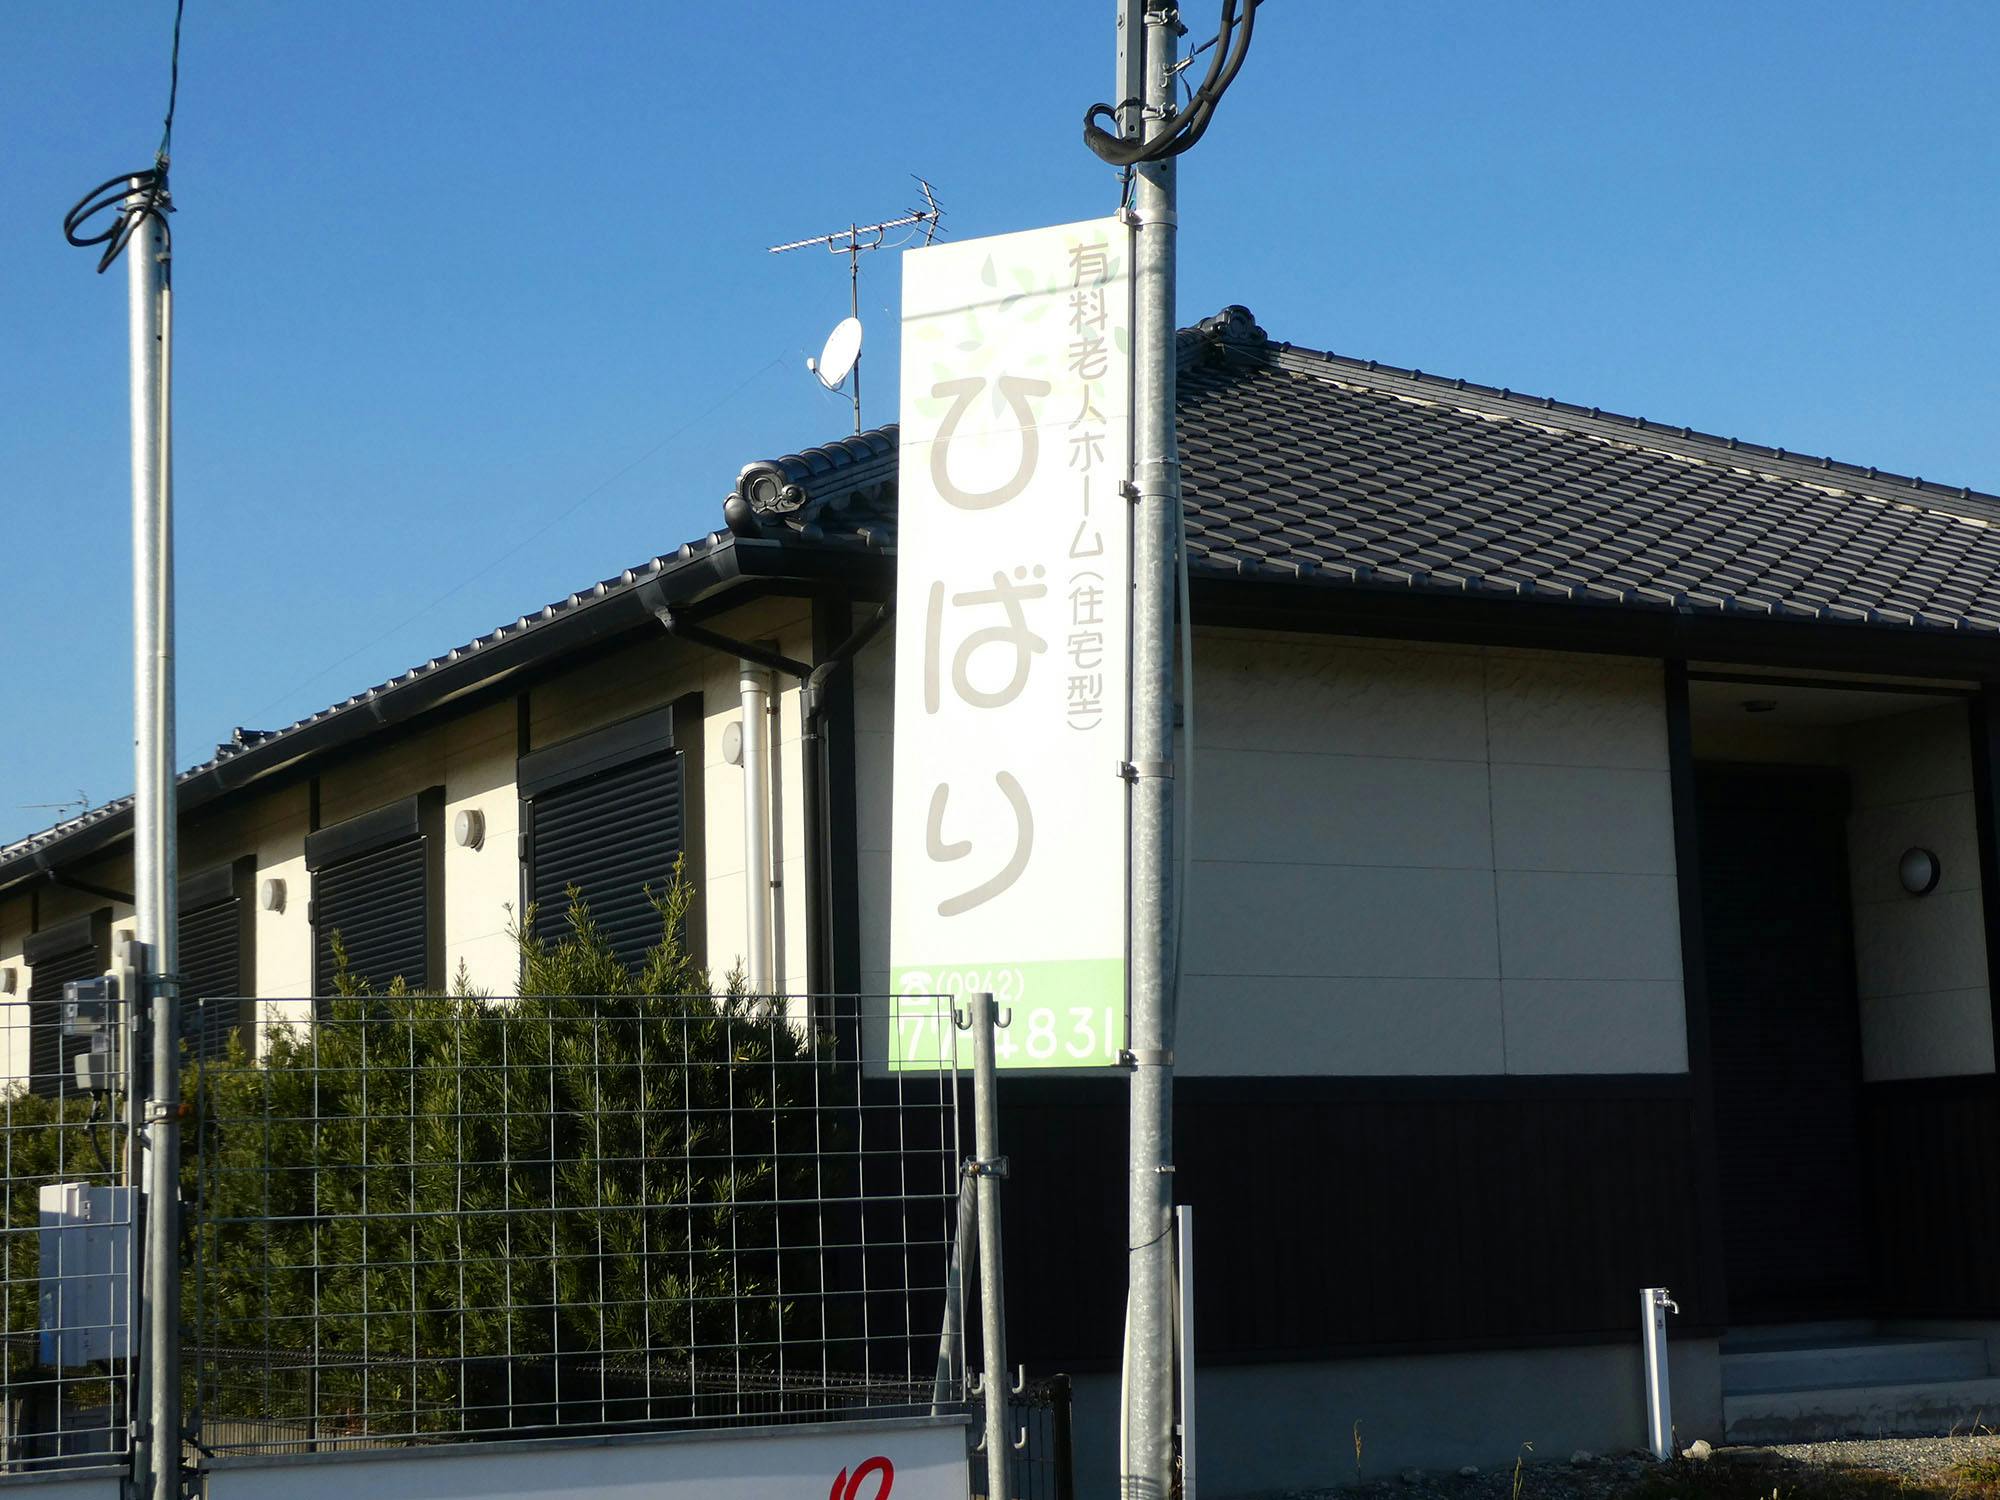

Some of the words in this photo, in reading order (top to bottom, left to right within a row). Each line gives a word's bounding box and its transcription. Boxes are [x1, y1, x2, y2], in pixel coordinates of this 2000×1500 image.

[924, 375, 1051, 917] ひばり
[1068, 243, 1109, 731] 有料老人ホーム(住宅型)
